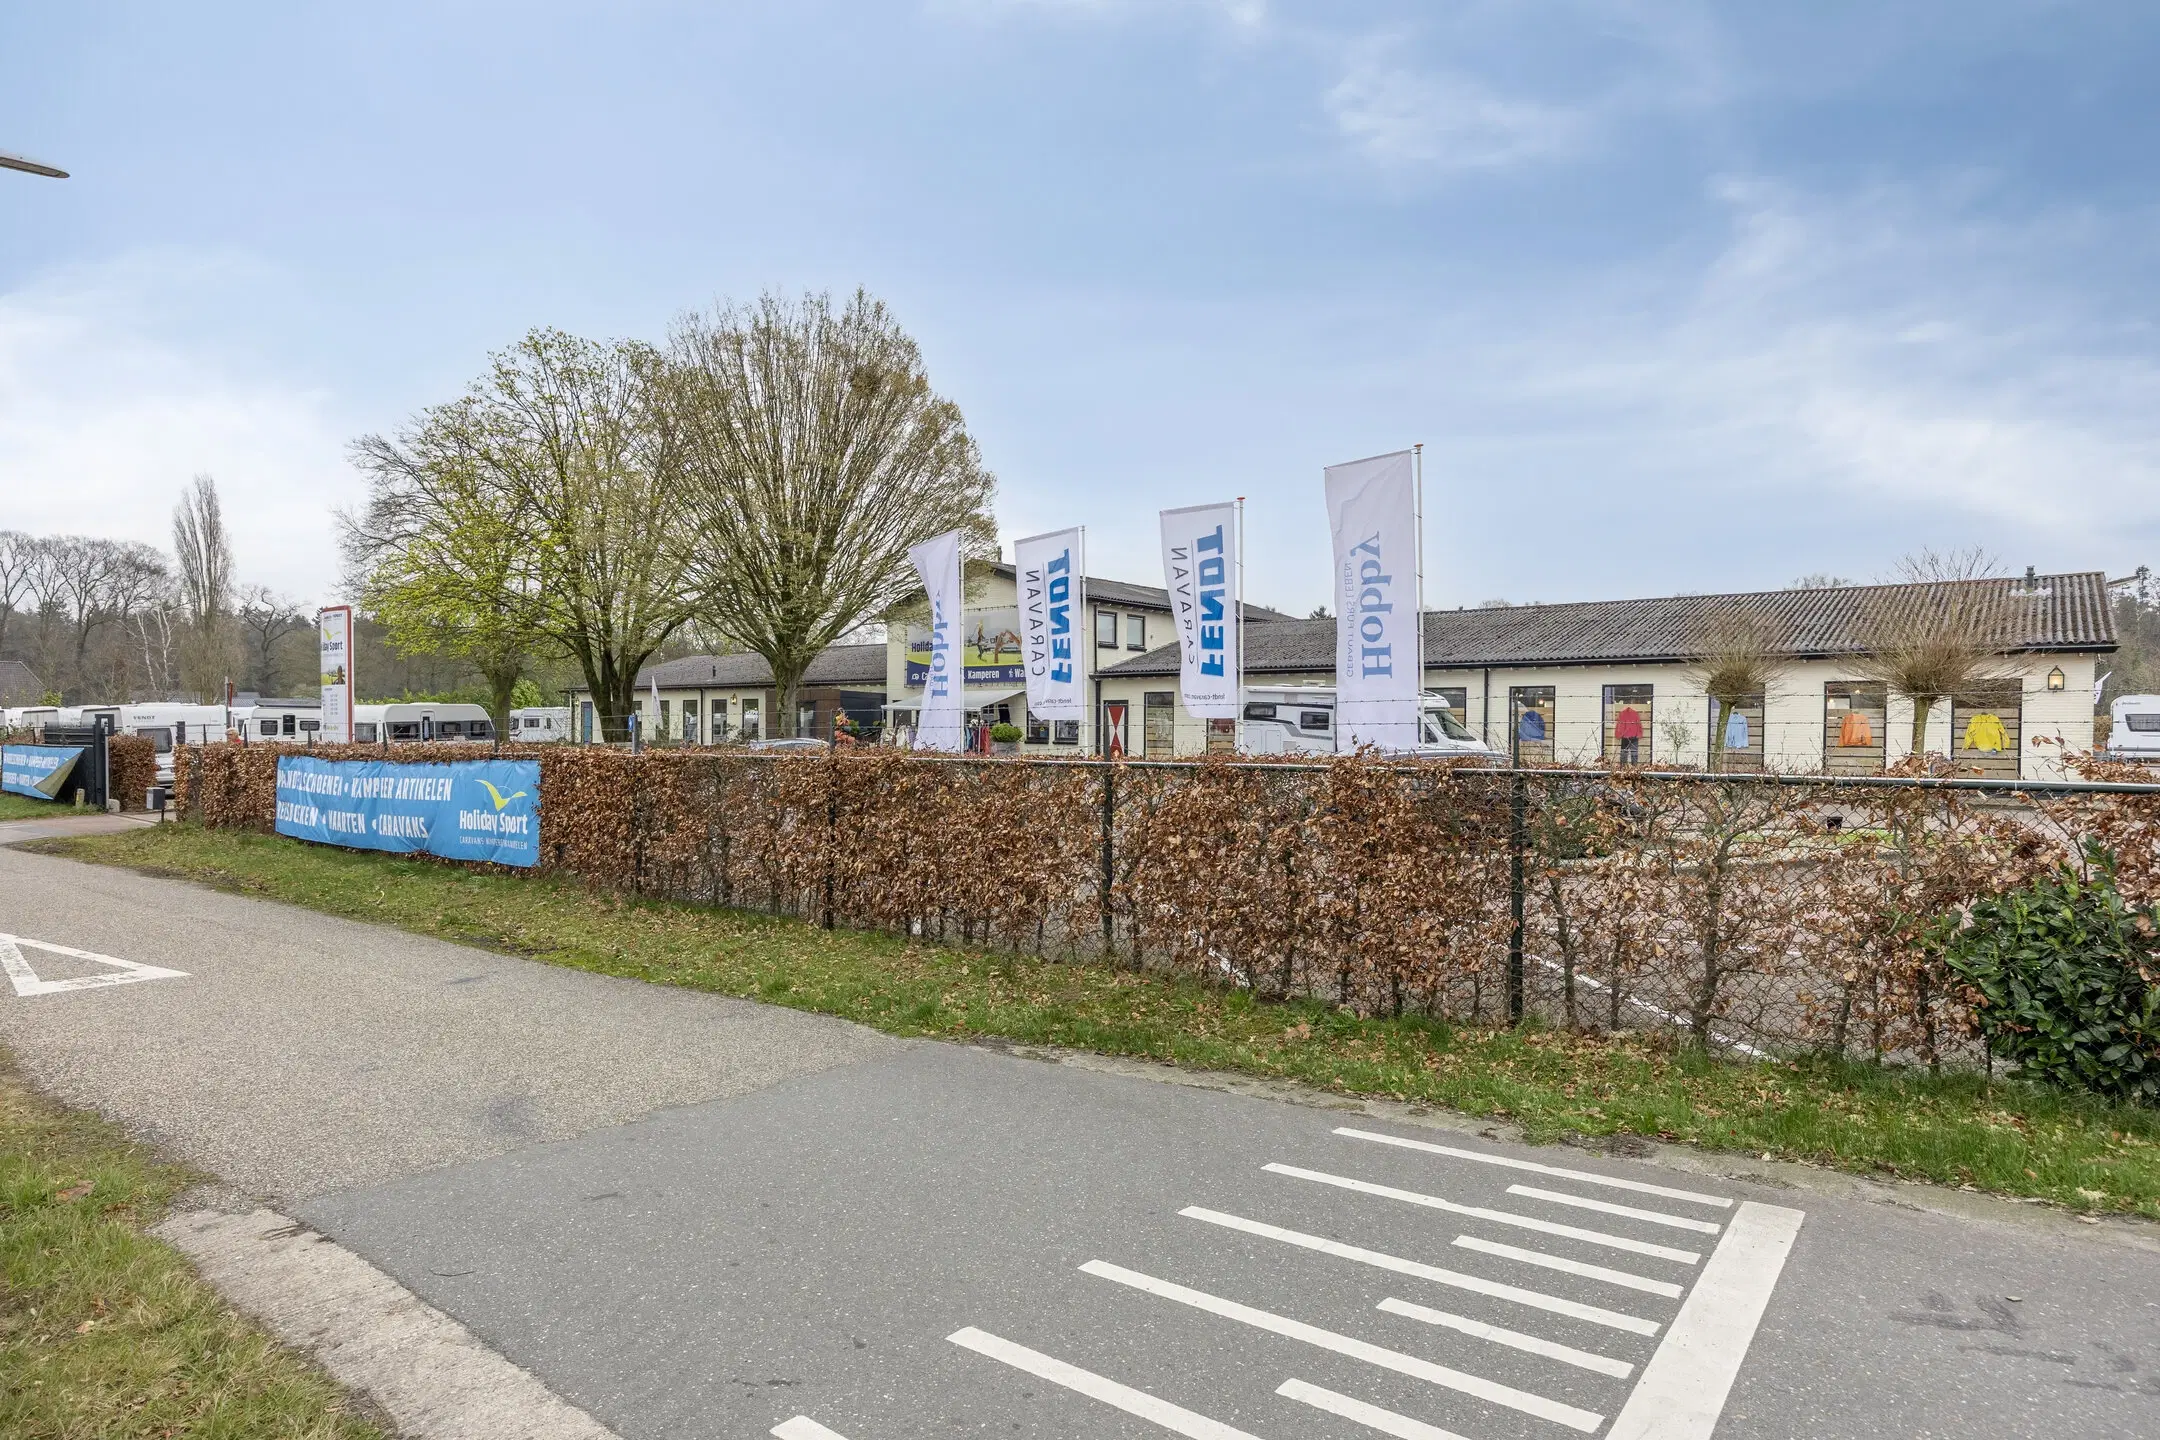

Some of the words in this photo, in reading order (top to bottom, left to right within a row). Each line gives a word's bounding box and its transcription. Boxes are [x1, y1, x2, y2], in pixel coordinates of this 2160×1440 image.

[911, 640, 933, 653] Holida
[967, 670, 1000, 680] Kamperen
[395, 778, 453, 801] ARTIKELEN
[379, 814, 429, 839] CARAVANS
[460, 809, 498, 835] Holiday
[500, 812, 528, 836] Sport
